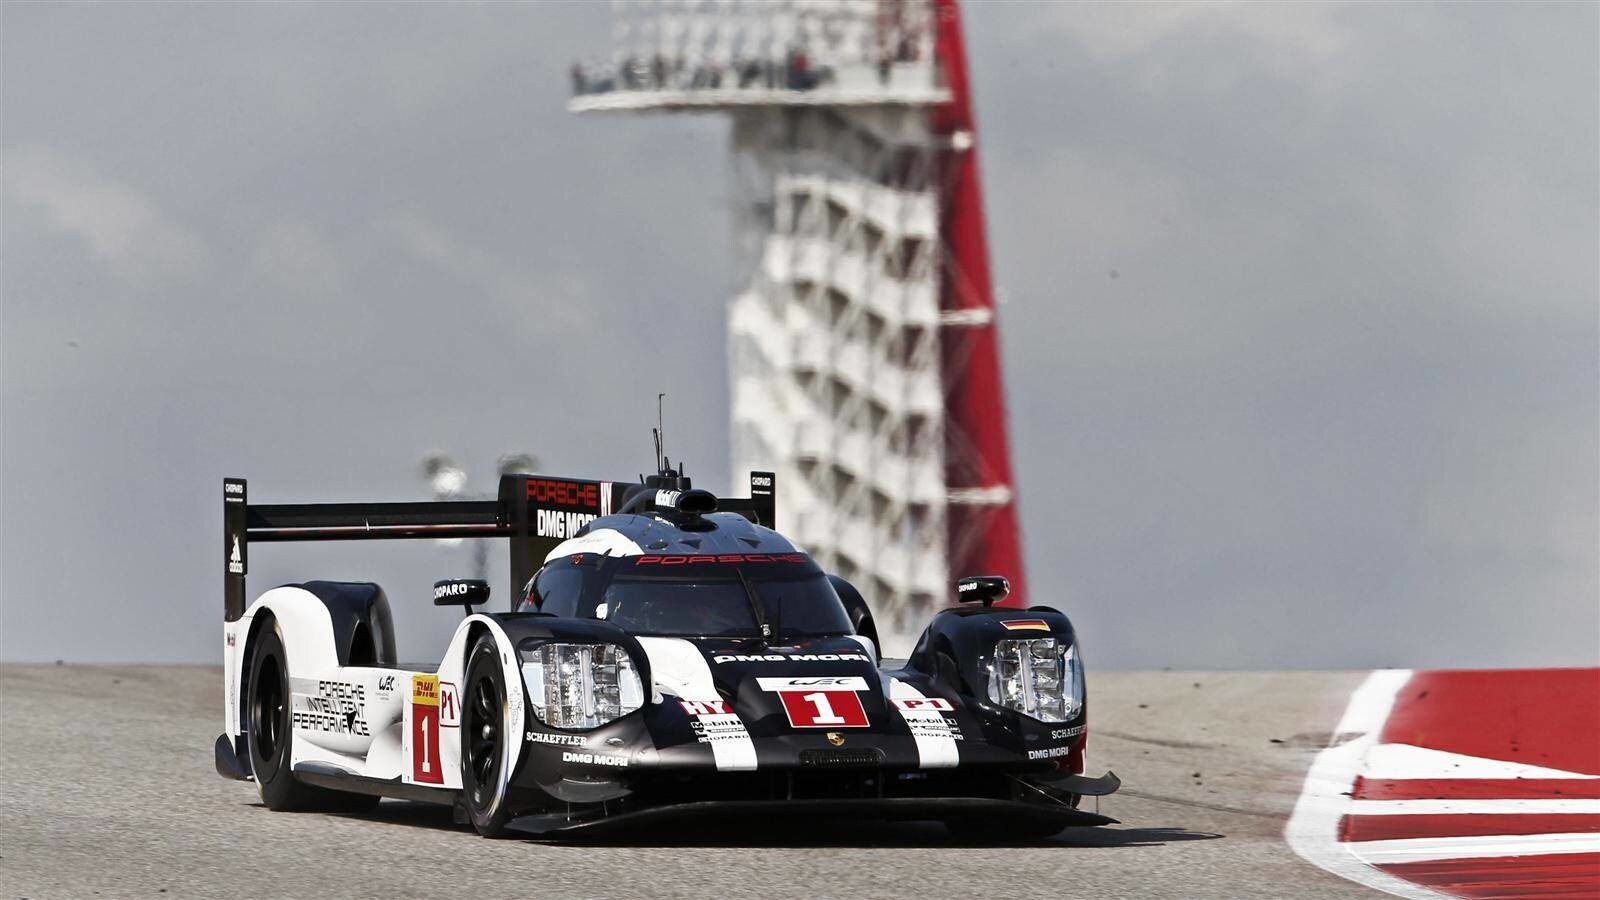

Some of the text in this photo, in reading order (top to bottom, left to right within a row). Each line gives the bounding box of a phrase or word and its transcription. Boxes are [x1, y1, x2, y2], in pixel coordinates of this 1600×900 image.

[526, 479, 597, 507] PORSCHE
[537, 508, 565, 539] DMG
[636, 554, 806, 566] PORSCHE
[713, 654, 870, 664] DMG MORI
[378, 676, 395, 691] WEC
[788, 678, 852, 686] WEC
[319, 680, 365, 701] PORSCHE
[306, 696, 365, 719] INTELLIGENT
[441, 690, 455, 720] P1
[680, 701, 727, 714] HY
[803, 692, 846, 724] 1
[902, 699, 944, 709] P1
[292, 712, 370, 736] PERFORMANCE
[690, 720, 729, 729] Mobil
[421, 715, 431, 773] 1
[526, 731, 588, 747] SCHAEFFLER
[562, 751, 629, 767] DMG MORI
[1028, 746, 1069, 760] DMG MORI
